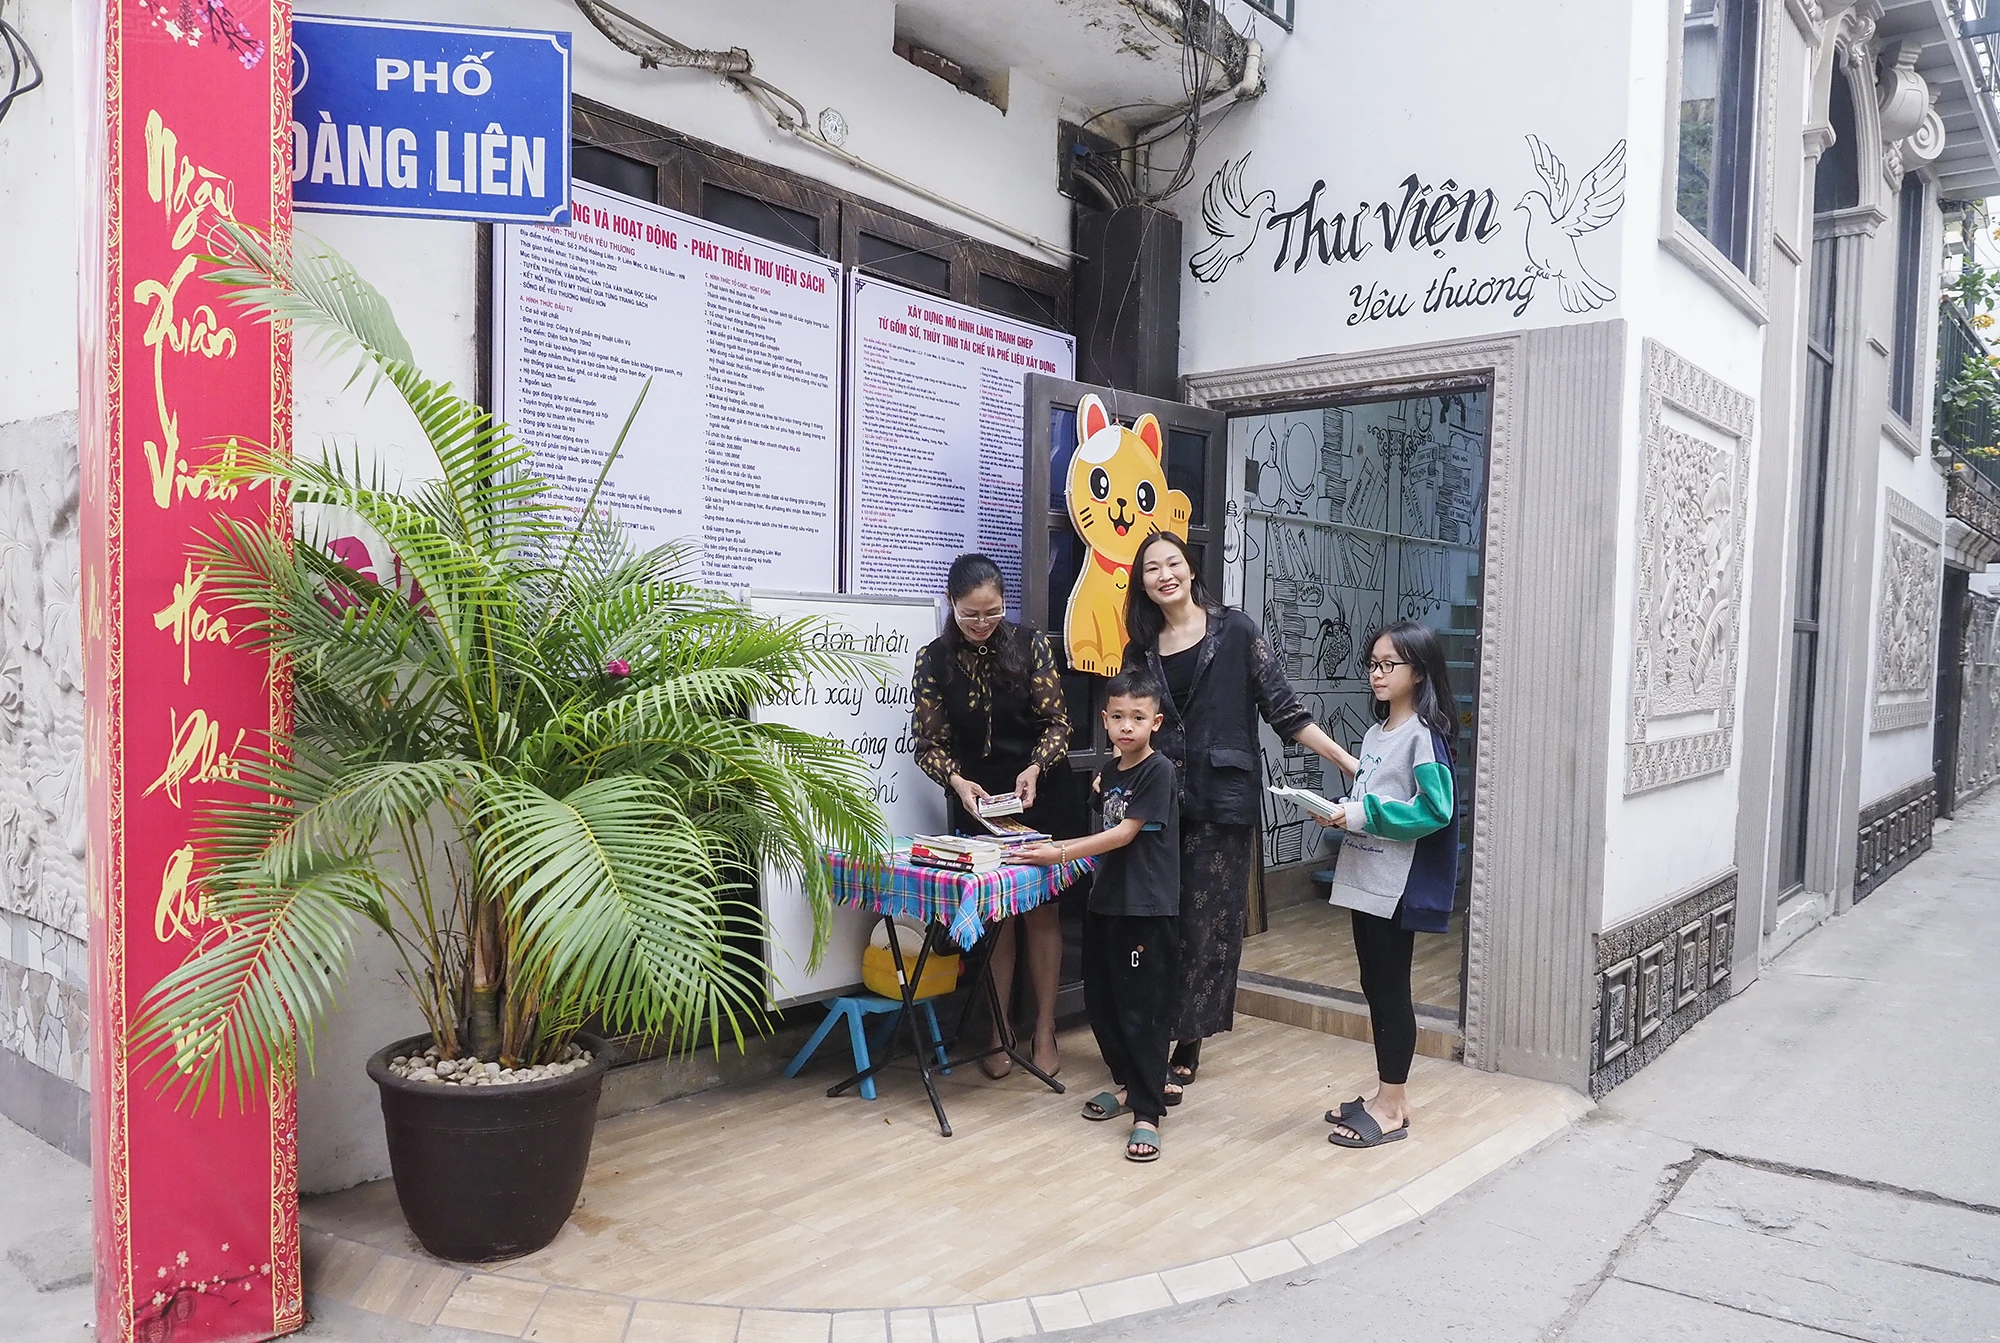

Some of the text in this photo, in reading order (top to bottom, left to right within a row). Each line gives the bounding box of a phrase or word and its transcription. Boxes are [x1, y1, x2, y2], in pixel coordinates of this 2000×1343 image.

[376, 51, 494, 96] PHỐ
[437, 122, 546, 198] LIÊN
[563, 228, 577, 239] THƯ
[578, 233, 593, 244] VIỆN
[595, 237, 608, 248] YÊU
[609, 241, 635, 256] THƯƠNG
[594, 207, 609, 231] VÀ
[613, 214, 643, 242] HOẠT
[646, 224, 677, 251] ĐỘNG
[691, 238, 719, 263] PHÁT
[721, 247, 751, 272] TRIỂN
[754, 257, 774, 279] THƯ
[775, 264, 797, 287] VIỆN
[800, 271, 826, 294] SÁCH
[1423, 266, 1537, 317] thương
[878, 316, 1056, 374] TỪ GỐM SỨ, THỦY TINH TÁI CHẾ VÀ PHẾ LIỆU XÂY DỰNG
[907, 304, 1034, 349] XÂY DỰNG MÔ HÌNH LÀNG TRANH GHÉP
[153, 558, 230, 685] Hoa
[863, 623, 909, 657] nhận
[824, 679, 863, 716] xây
[852, 731, 888, 769] cộng
